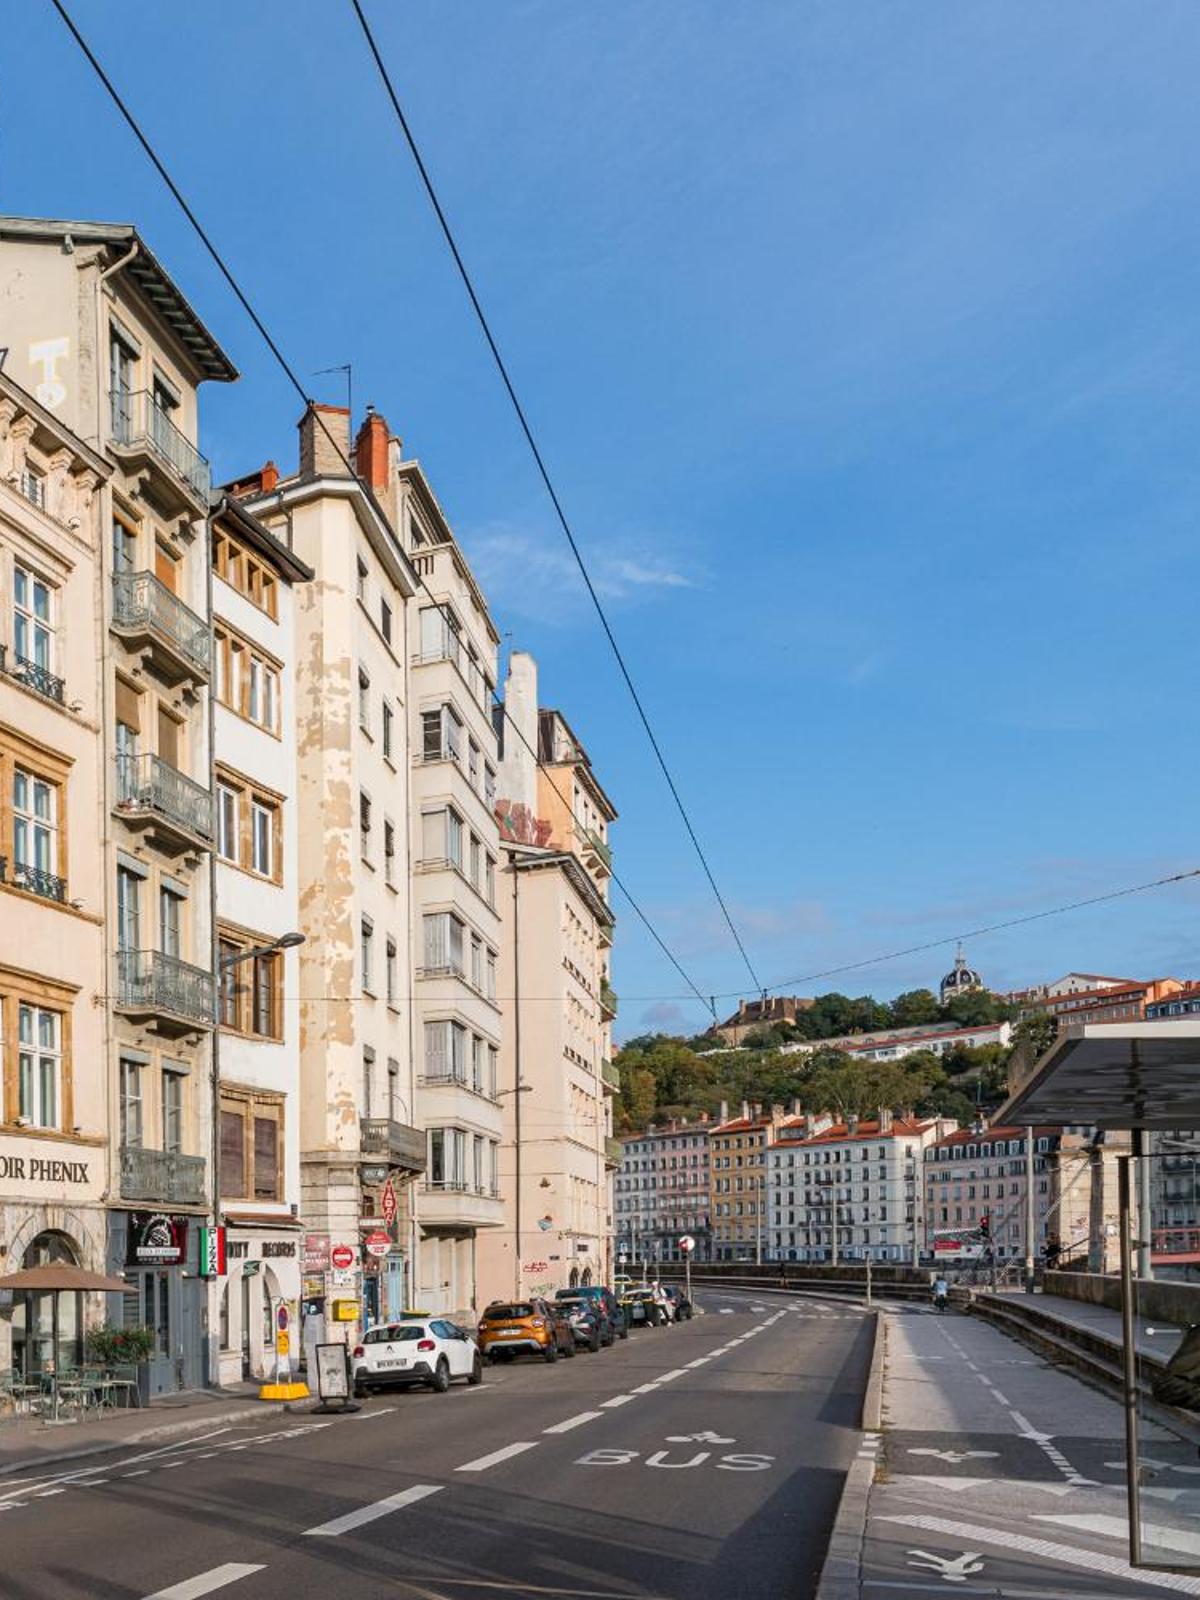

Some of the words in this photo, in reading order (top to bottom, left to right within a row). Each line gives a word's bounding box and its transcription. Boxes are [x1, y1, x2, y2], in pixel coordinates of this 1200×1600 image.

[29, 1158, 90, 1183] PHENIX
[208, 1228, 216, 1272] PIZZA
[572, 1448, 776, 1472] BUS
